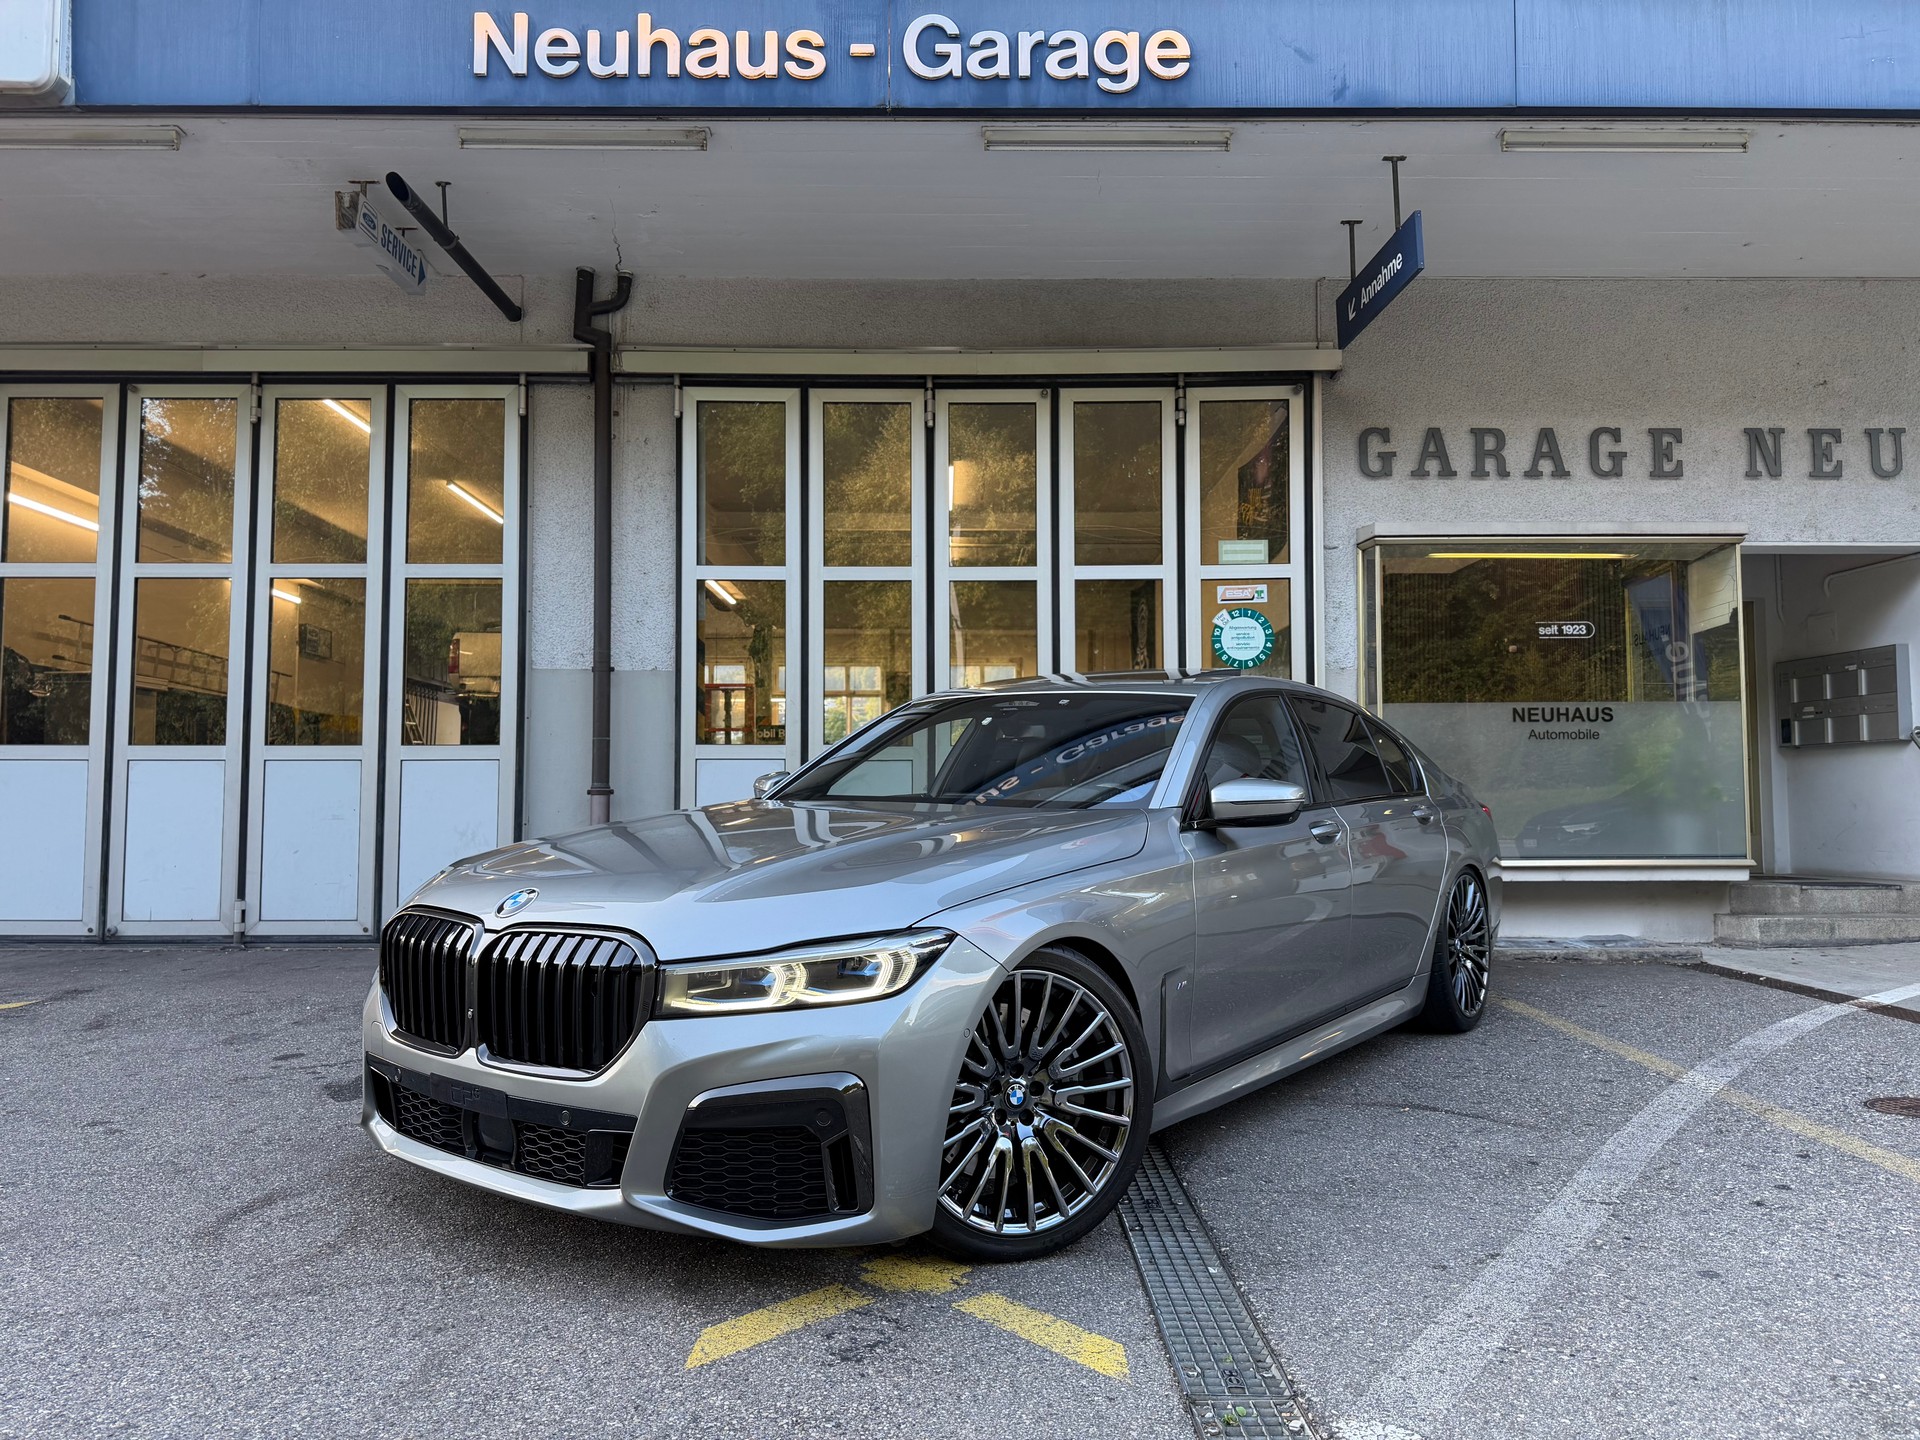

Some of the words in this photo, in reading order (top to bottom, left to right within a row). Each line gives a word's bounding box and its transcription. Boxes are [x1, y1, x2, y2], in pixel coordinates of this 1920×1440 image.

[474, 12, 827, 79] Neuhaus
[850, 43, 876, 57] -
[902, 13, 1191, 94] Garage
[380, 223, 418, 278] SERVICE
[1360, 252, 1403, 309] Annahme
[1358, 427, 1684, 478] GARAGE
[1744, 427, 1907, 478] NEU
[1214, 628, 1221, 636] 10
[1538, 625, 1559, 635] seit
[1561, 625, 1587, 635] 1923
[1512, 707, 1614, 723] NEUHAUS
[1528, 729, 1600, 740] Automobile
